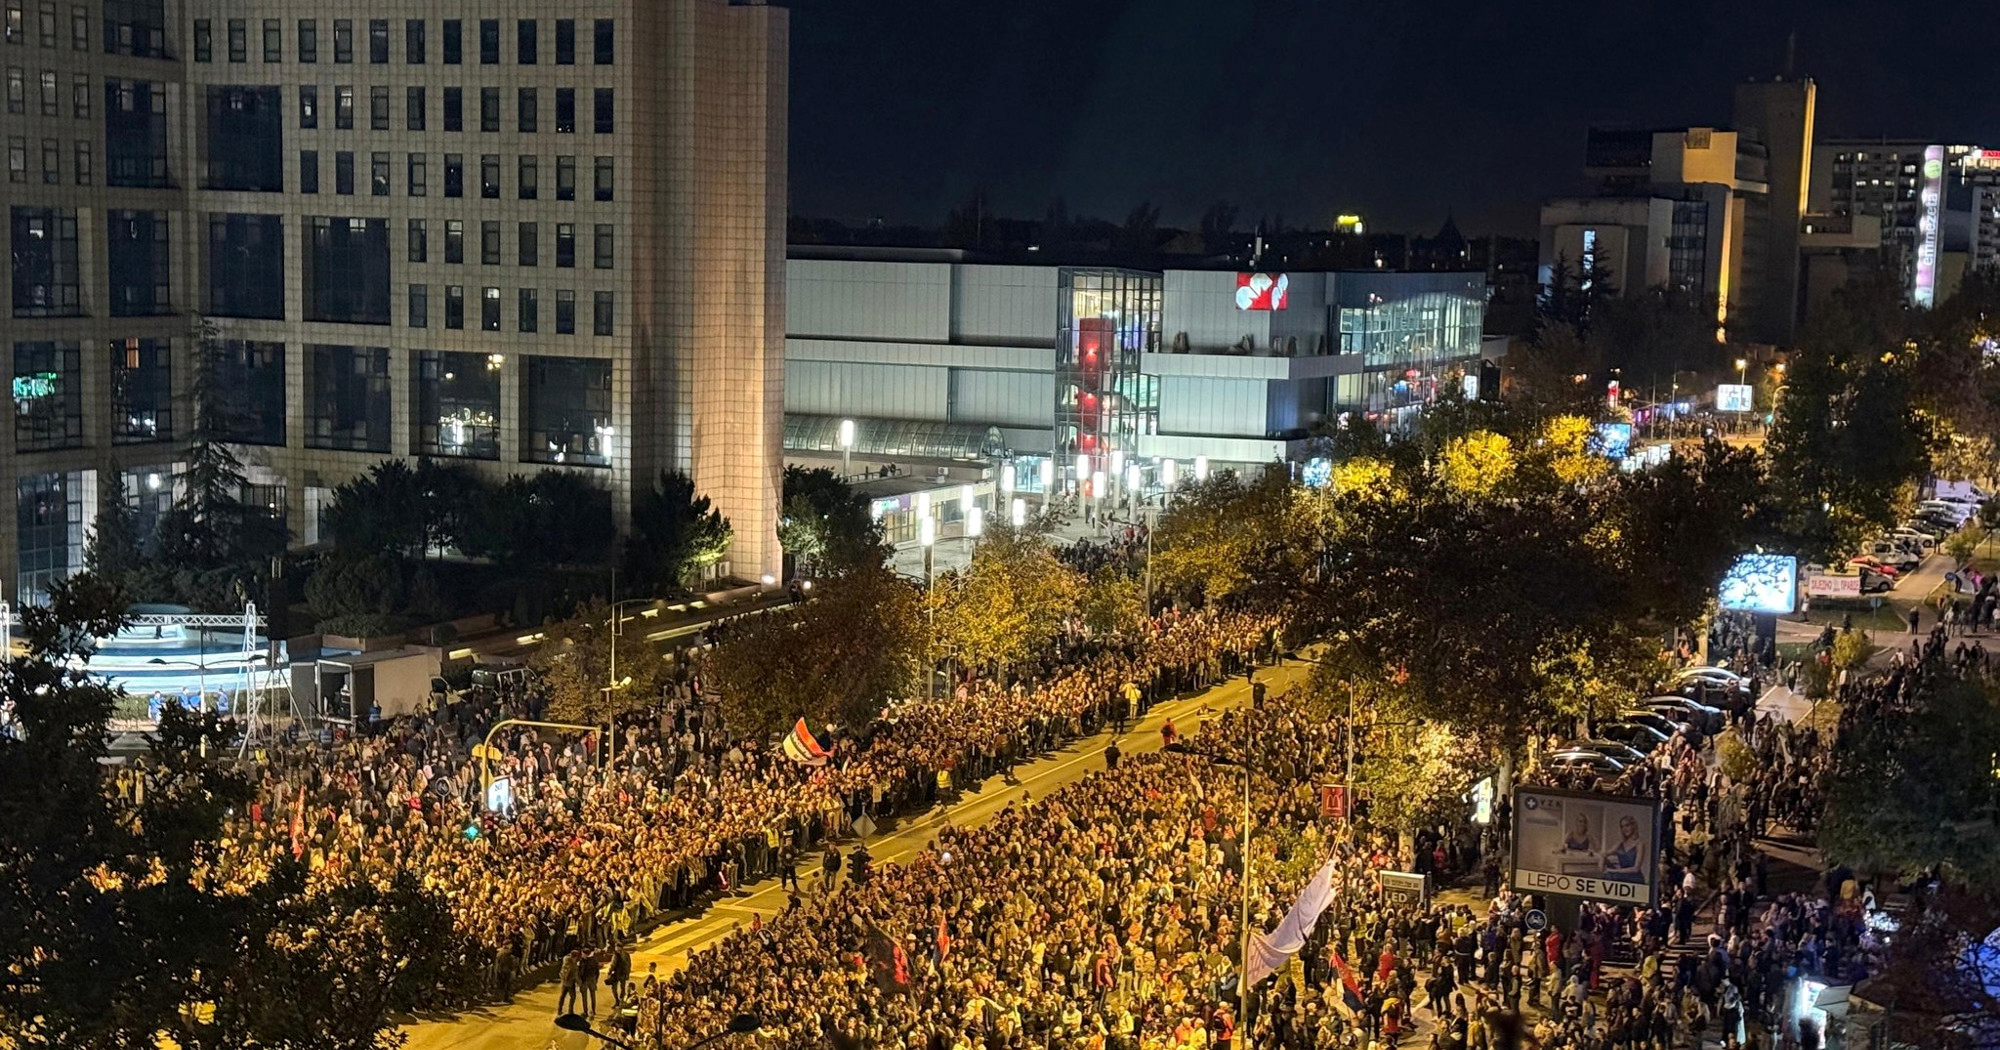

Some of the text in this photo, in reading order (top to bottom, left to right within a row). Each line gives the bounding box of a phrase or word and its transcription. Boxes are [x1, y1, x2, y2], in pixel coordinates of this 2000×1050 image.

[1923, 193, 1938, 266] emmezeta
[1385, 891, 1408, 903] LED
[1527, 873, 1635, 898] LEPO SE VIDI
